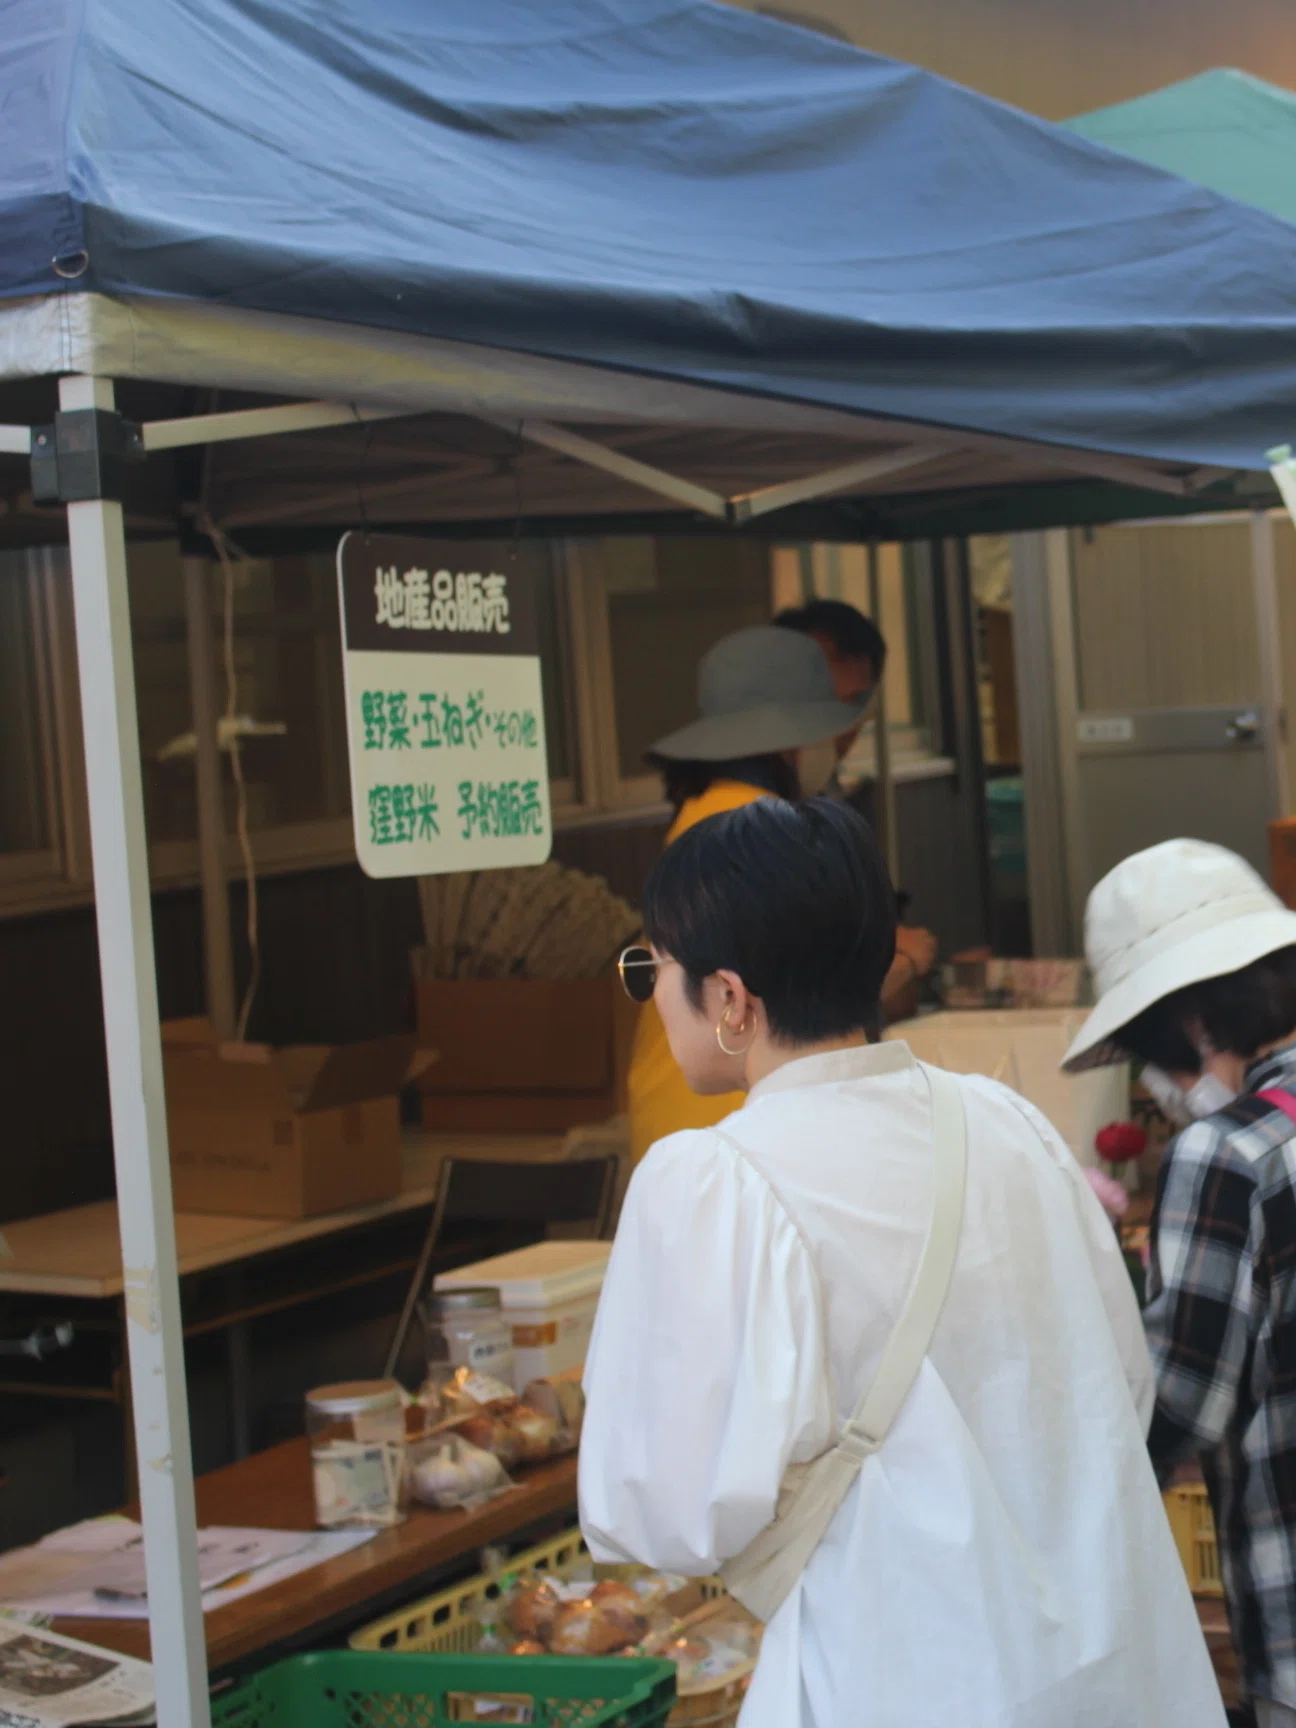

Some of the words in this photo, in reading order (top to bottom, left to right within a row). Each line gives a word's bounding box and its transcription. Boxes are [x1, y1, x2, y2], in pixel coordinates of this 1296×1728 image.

[374, 564, 512, 635] 地産品販売
[368, 782, 441, 846] 窪野米
[457, 779, 543, 839] 予約販売
